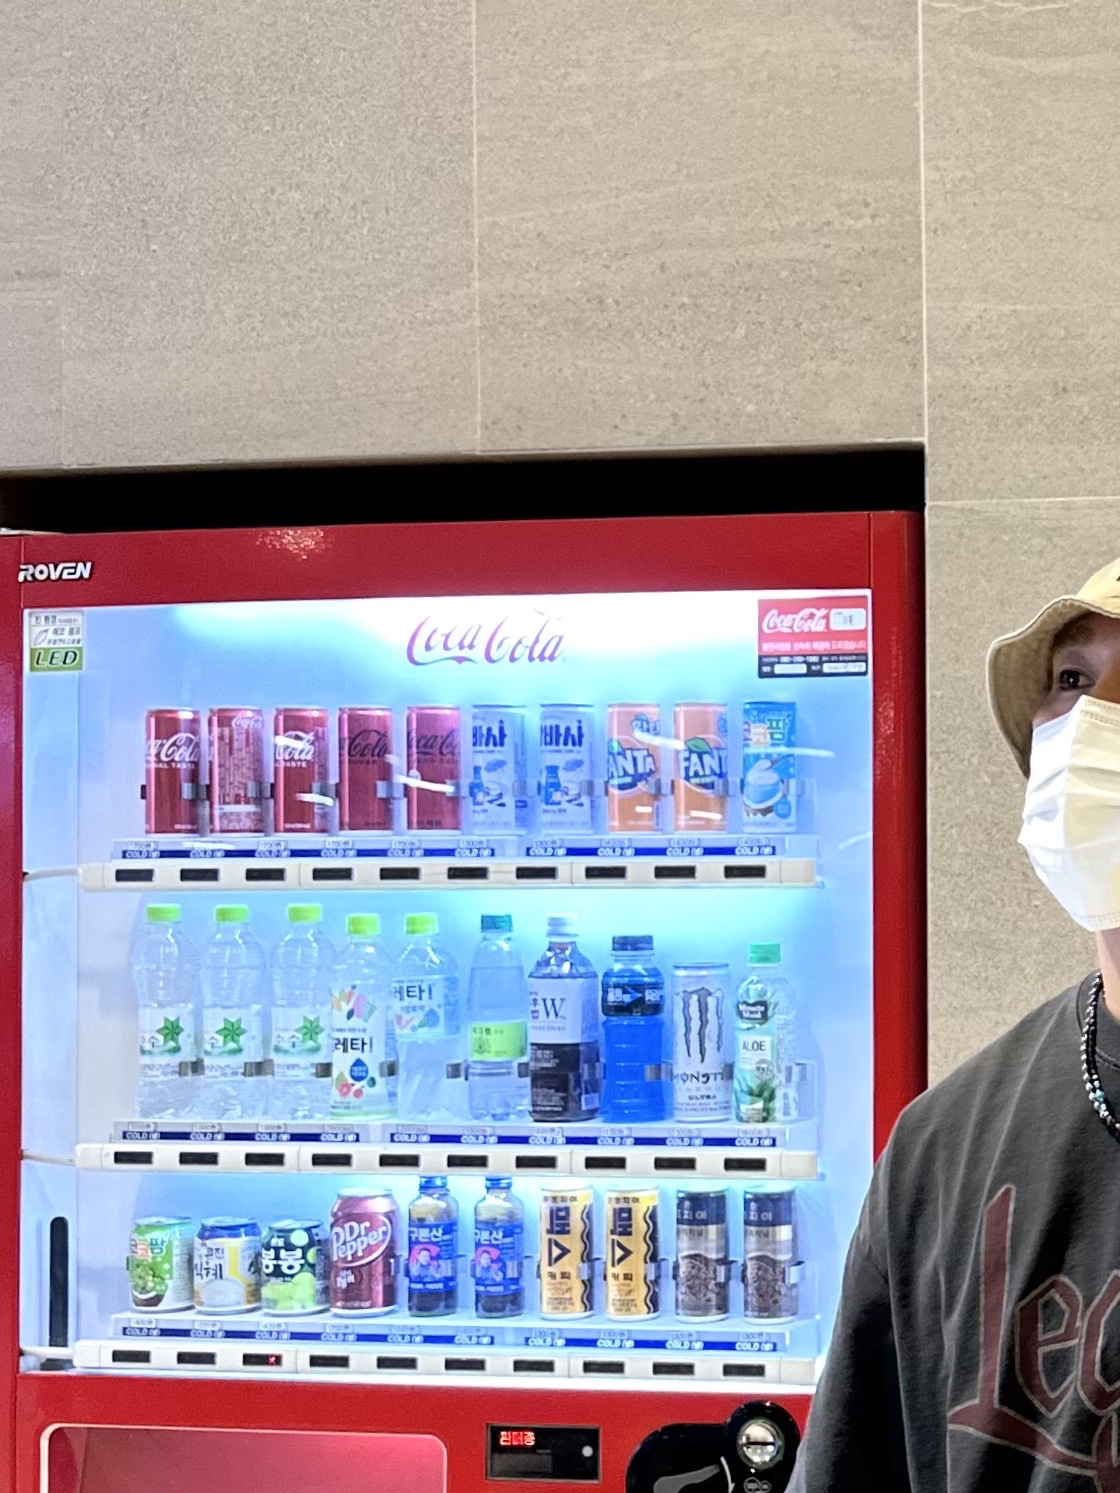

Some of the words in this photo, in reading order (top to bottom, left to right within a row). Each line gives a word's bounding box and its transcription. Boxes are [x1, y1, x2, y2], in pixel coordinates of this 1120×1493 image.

[17, 561, 93, 583] ROVEN
[762, 607, 829, 634] Coca-Cola
[406, 606, 569, 667] CocaCola
[35, 651, 78, 666] LED
[607, 749, 656, 782] ANTA
[679, 748, 728, 780] FANT
[126, 850, 148, 858] COLD
[190, 850, 212, 858] COLD
[255, 850, 278, 858] COLD
[321, 849, 344, 857] COLD
[388, 849, 410, 857] COLD
[455, 849, 478, 857] COLD
[529, 848, 553, 856] COLD
[598, 848, 621, 856] COLD
[666, 847, 690, 856] COLD
[735, 847, 759, 855] COLD
[334, 1036, 373, 1053] 레타!
[743, 1040, 767, 1051] ALOE
[126, 1132, 148, 1140] COLD
[190, 1132, 212, 1140] COLD
[255, 1133, 277, 1141] COLD
[320, 1134, 344, 1142] COLD
[393, 1134, 417, 1142] COLD
[461, 1135, 485, 1143] COLD
[529, 1136, 552, 1144] COLD
[597, 1137, 621, 1145] COLD
[666, 1137, 690, 1146] COLD
[735, 1138, 759, 1146] COLD
[344, 1220, 371, 1242] Dr
[331, 1226, 388, 1262] Pepper
[262, 1248, 305, 1275] 봉봉
[126, 1328, 148, 1336] COLD
[190, 1330, 212, 1338] COLD
[255, 1331, 278, 1339] COLD
[321, 1333, 344, 1341] COLD
[388, 1335, 411, 1343] COLD
[454, 1336, 477, 1344] COLD
[528, 1337, 552, 1346] COLD
[597, 1339, 621, 1347] COLD
[666, 1340, 690, 1349] COLD
[735, 1342, 759, 1351] COLD
